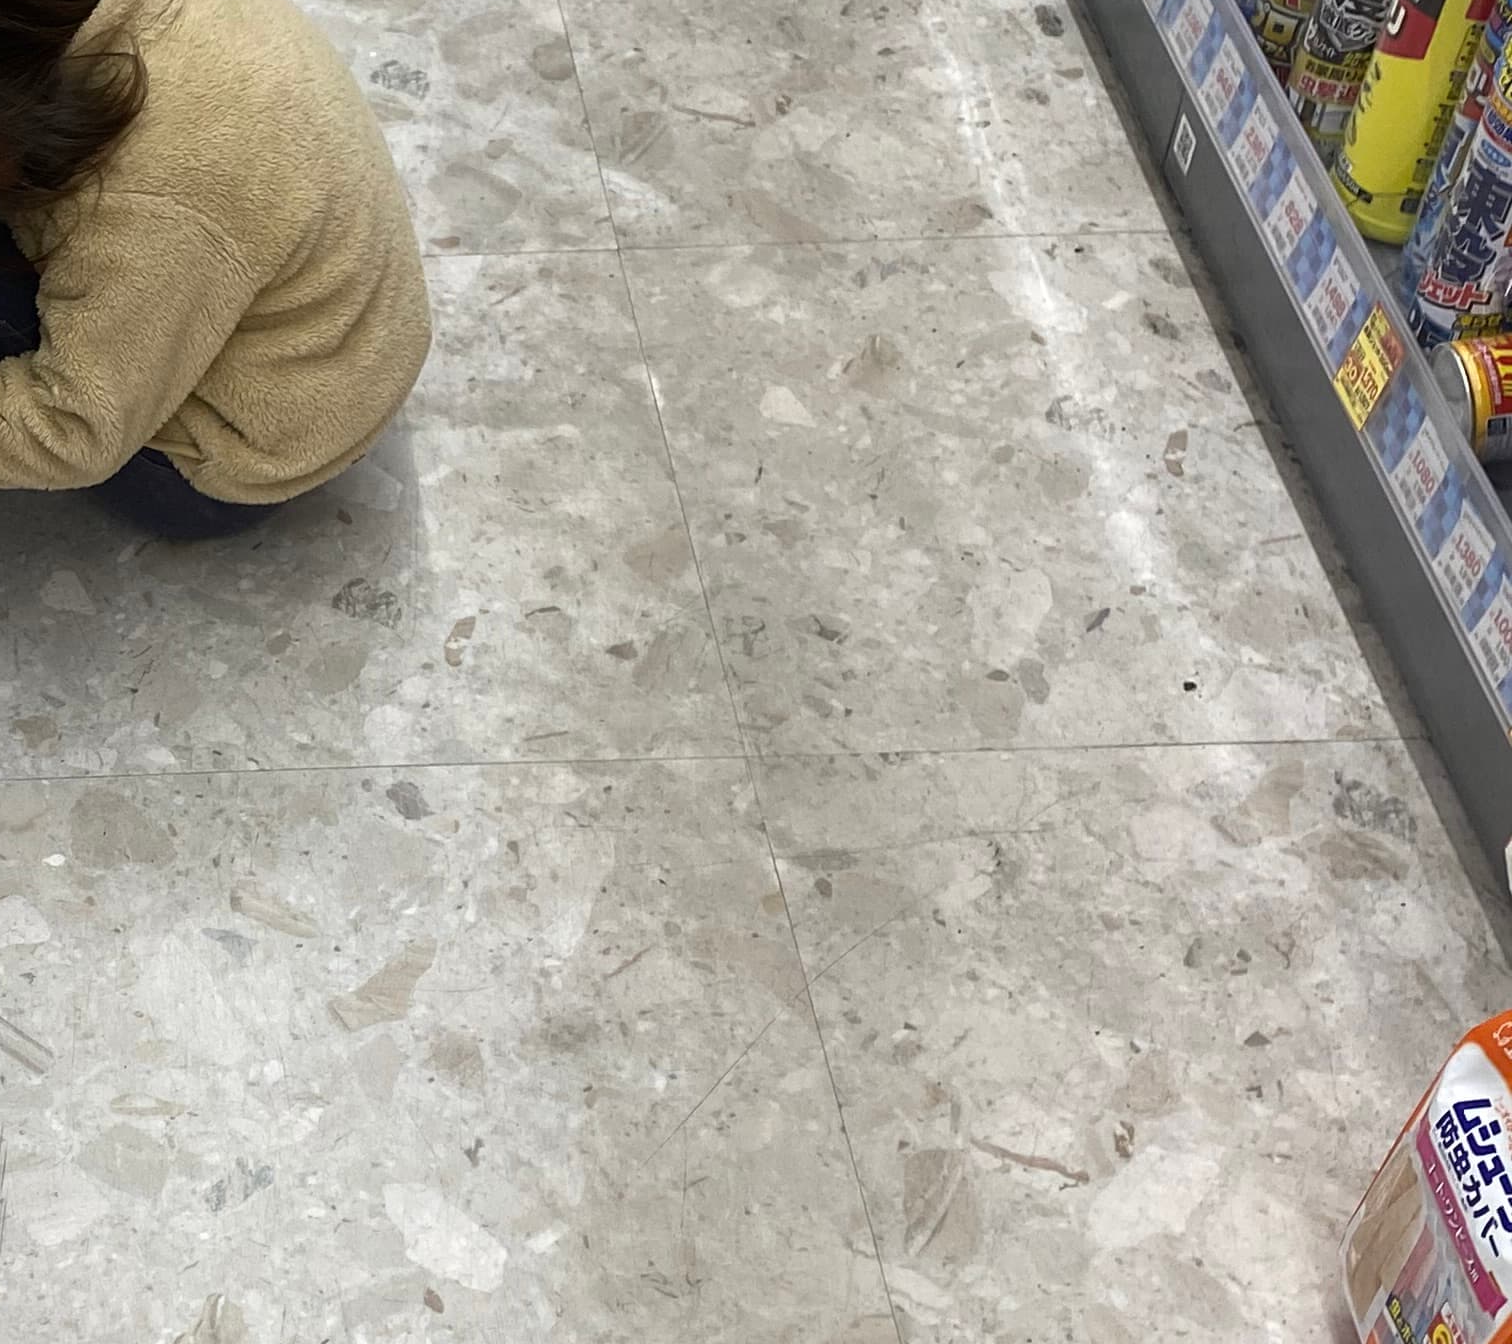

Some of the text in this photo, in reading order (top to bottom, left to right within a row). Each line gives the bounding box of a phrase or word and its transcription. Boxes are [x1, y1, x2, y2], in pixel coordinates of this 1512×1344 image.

[1455, 533, 1482, 577] 1,380
[1436, 1110, 1501, 1258] 防虫カバー
